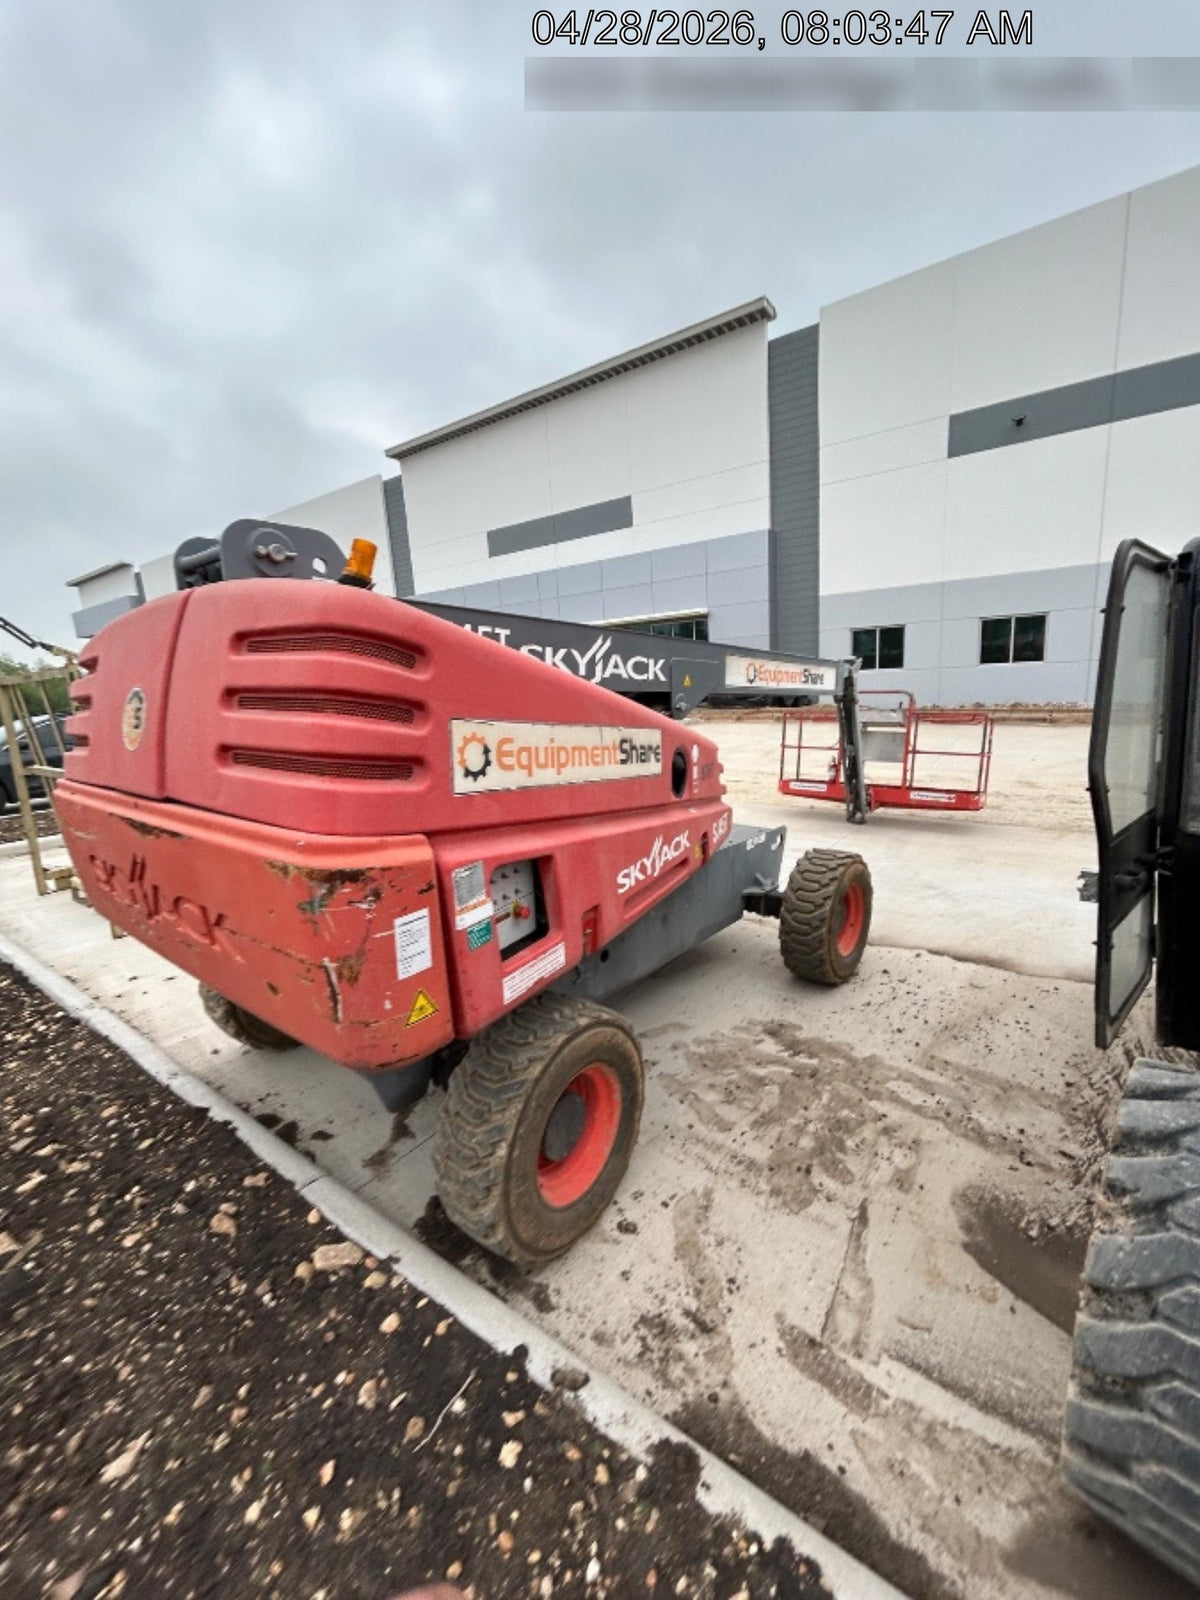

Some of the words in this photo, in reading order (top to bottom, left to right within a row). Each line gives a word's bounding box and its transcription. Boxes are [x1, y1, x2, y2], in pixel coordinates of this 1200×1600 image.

[519, 634, 667, 684] SKYJACK
[757, 664, 824, 687] EquipmentShare
[495, 736, 661, 778] EquipmentShare
[616, 830, 690, 894] SKYJACK
